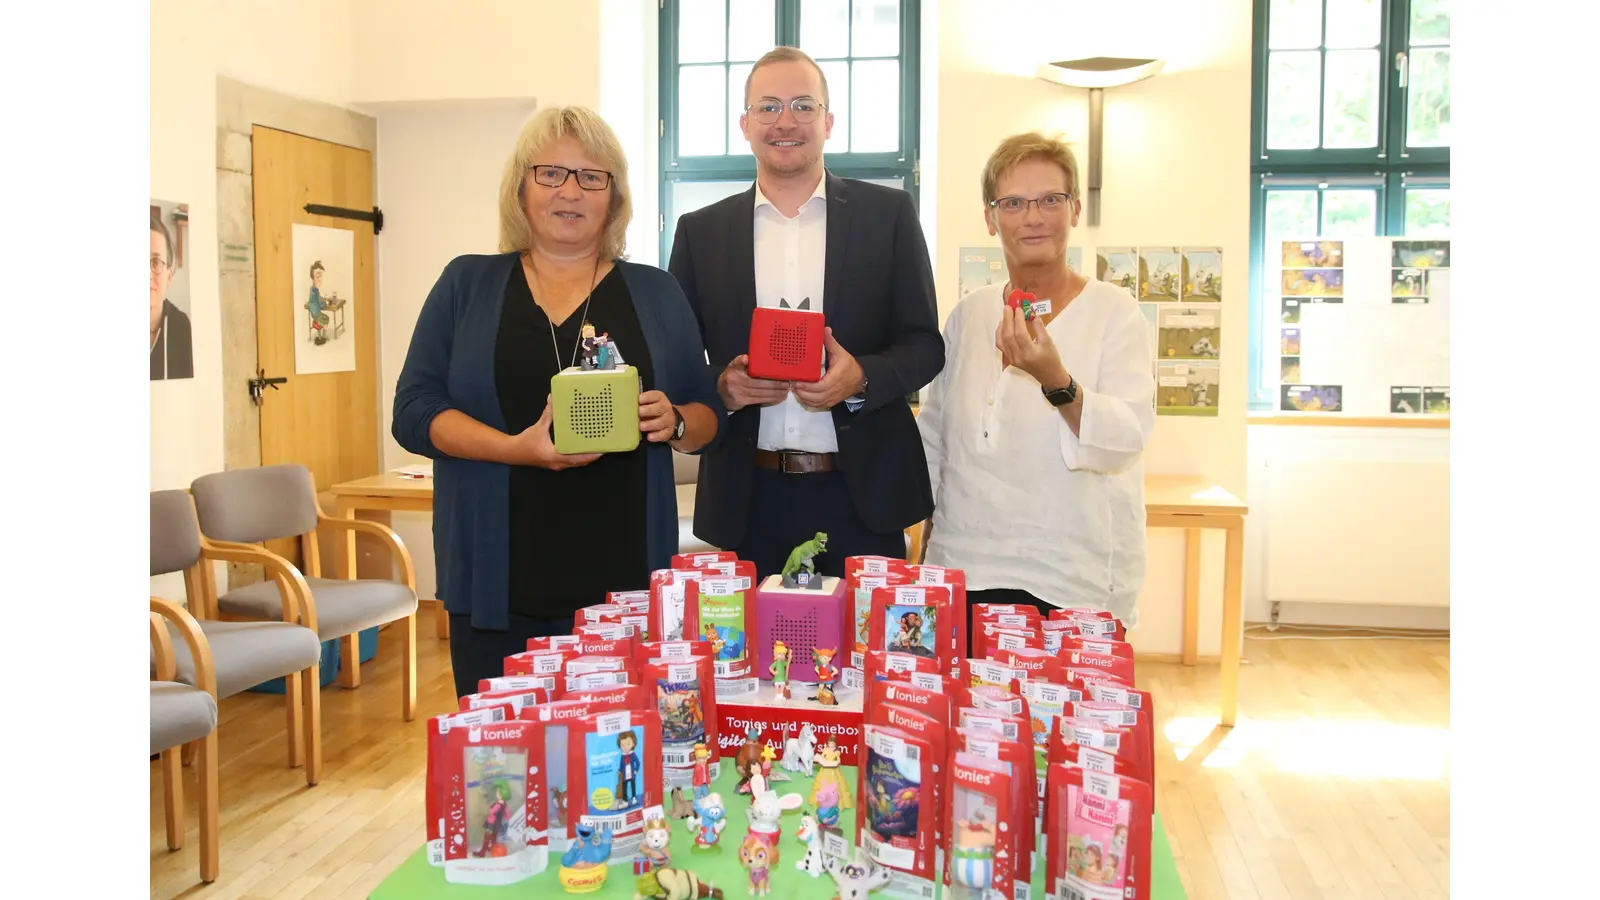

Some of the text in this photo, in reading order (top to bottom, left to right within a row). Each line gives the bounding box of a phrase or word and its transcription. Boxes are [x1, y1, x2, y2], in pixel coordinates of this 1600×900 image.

[584, 642, 615, 653] tonies
[1081, 655, 1113, 668] tonies
[896, 690, 928, 705] tonies
[553, 706, 588, 719] tonies
[725, 716, 768, 730] Tonies
[895, 713, 925, 732] tonies
[483, 727, 522, 741] tonies
